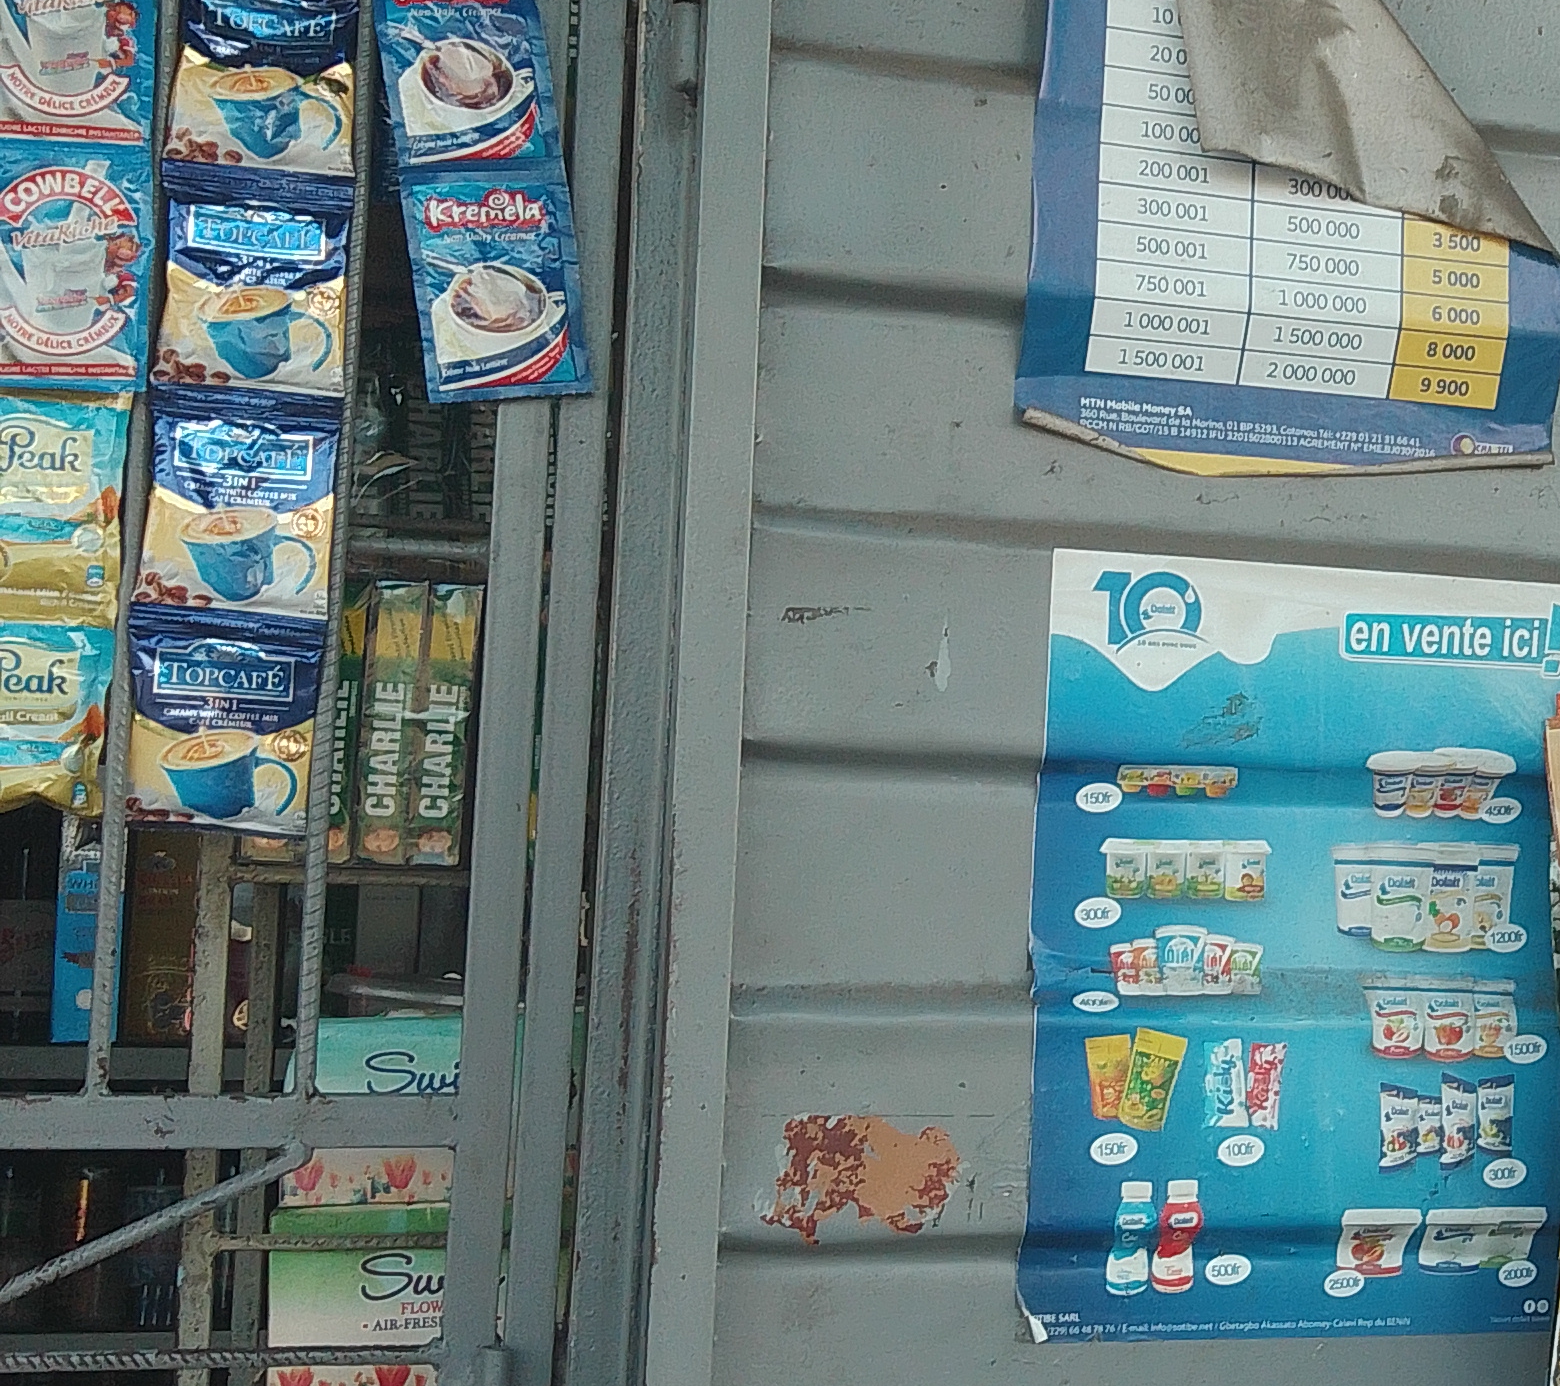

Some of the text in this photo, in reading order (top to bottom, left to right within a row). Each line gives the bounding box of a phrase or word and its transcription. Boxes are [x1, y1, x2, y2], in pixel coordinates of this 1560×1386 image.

[1150, 46, 1172, 63] 20
[8, 72, 121, 111] NOTRE DÉLICE CRÉMEUX
[1148, 84, 1170, 101] 50
[1140, 121, 1174, 140] 100
[1138, 160, 1210, 184] 200 001
[4, 171, 121, 215] COWBELL
[1288, 178, 1322, 198] 300
[429, 193, 542, 227] Kremela
[1137, 198, 1209, 222] 300 001
[1286, 216, 1481, 253] 500 000 3 500
[1136, 236, 1208, 260] 500 001
[1286, 252, 1481, 290] 750 000 5 000
[1134, 274, 1208, 298] 750 001
[1278, 288, 1481, 326] 1 000 000 6 000
[5, 313, 120, 350] NOTRE DÉLICE CRÉMEUX
[1123, 311, 1210, 336] 1 000 001
[1273, 325, 1476, 362] 1 500 000 8 000
[1118, 348, 1205, 373] 1 500 001
[1266, 362, 1470, 397] 2 000 000 9 900
[1080, 396, 1193, 417] MTN Mobile Money SA
[1080, 408, 1098, 419] 360
[1121, 412, 1167, 425] Boulevard
[1168, 417, 1181, 426] de
[1182, 418, 1190, 427] la
[1226, 422, 1238, 431] 01
[1240, 423, 1252, 432] BP
[1280, 426, 1318, 438] Cotonou
[1358, 432, 1369, 442] 01
[1409, 437, 1420, 447] 41
[1170, 427, 1178, 436] B
[0, 424, 82, 473] Peak
[190, 436, 305, 470] TOPCAFÉ
[1092, 570, 1202, 645] 10
[1349, 619, 1392, 653] en
[1401, 618, 1493, 657] vente
[164, 661, 285, 692] TOPCAFÉ
[16, 711, 59, 722] Cream
[163, 707, 199, 718] CREAMY
[199, 709, 228, 720] WHITE
[261, 713, 279, 723] MIX
[364, 681, 406, 817] CHARLIE
[418, 684, 459, 819] CHARLIE
[1081, 791, 1515, 817] 150fr 450fr
[1080, 907, 1525, 945] 300fr 1200fr
[1507, 1041, 1542, 1057] 1500fr
[1096, 1142, 1519, 1181] 150fr 100fr 300fr
[1211, 1263, 1242, 1278] 500fr
[1327, 1276, 1361, 1291] 2500fr
[1058, 1313, 1080, 1323] SARL
